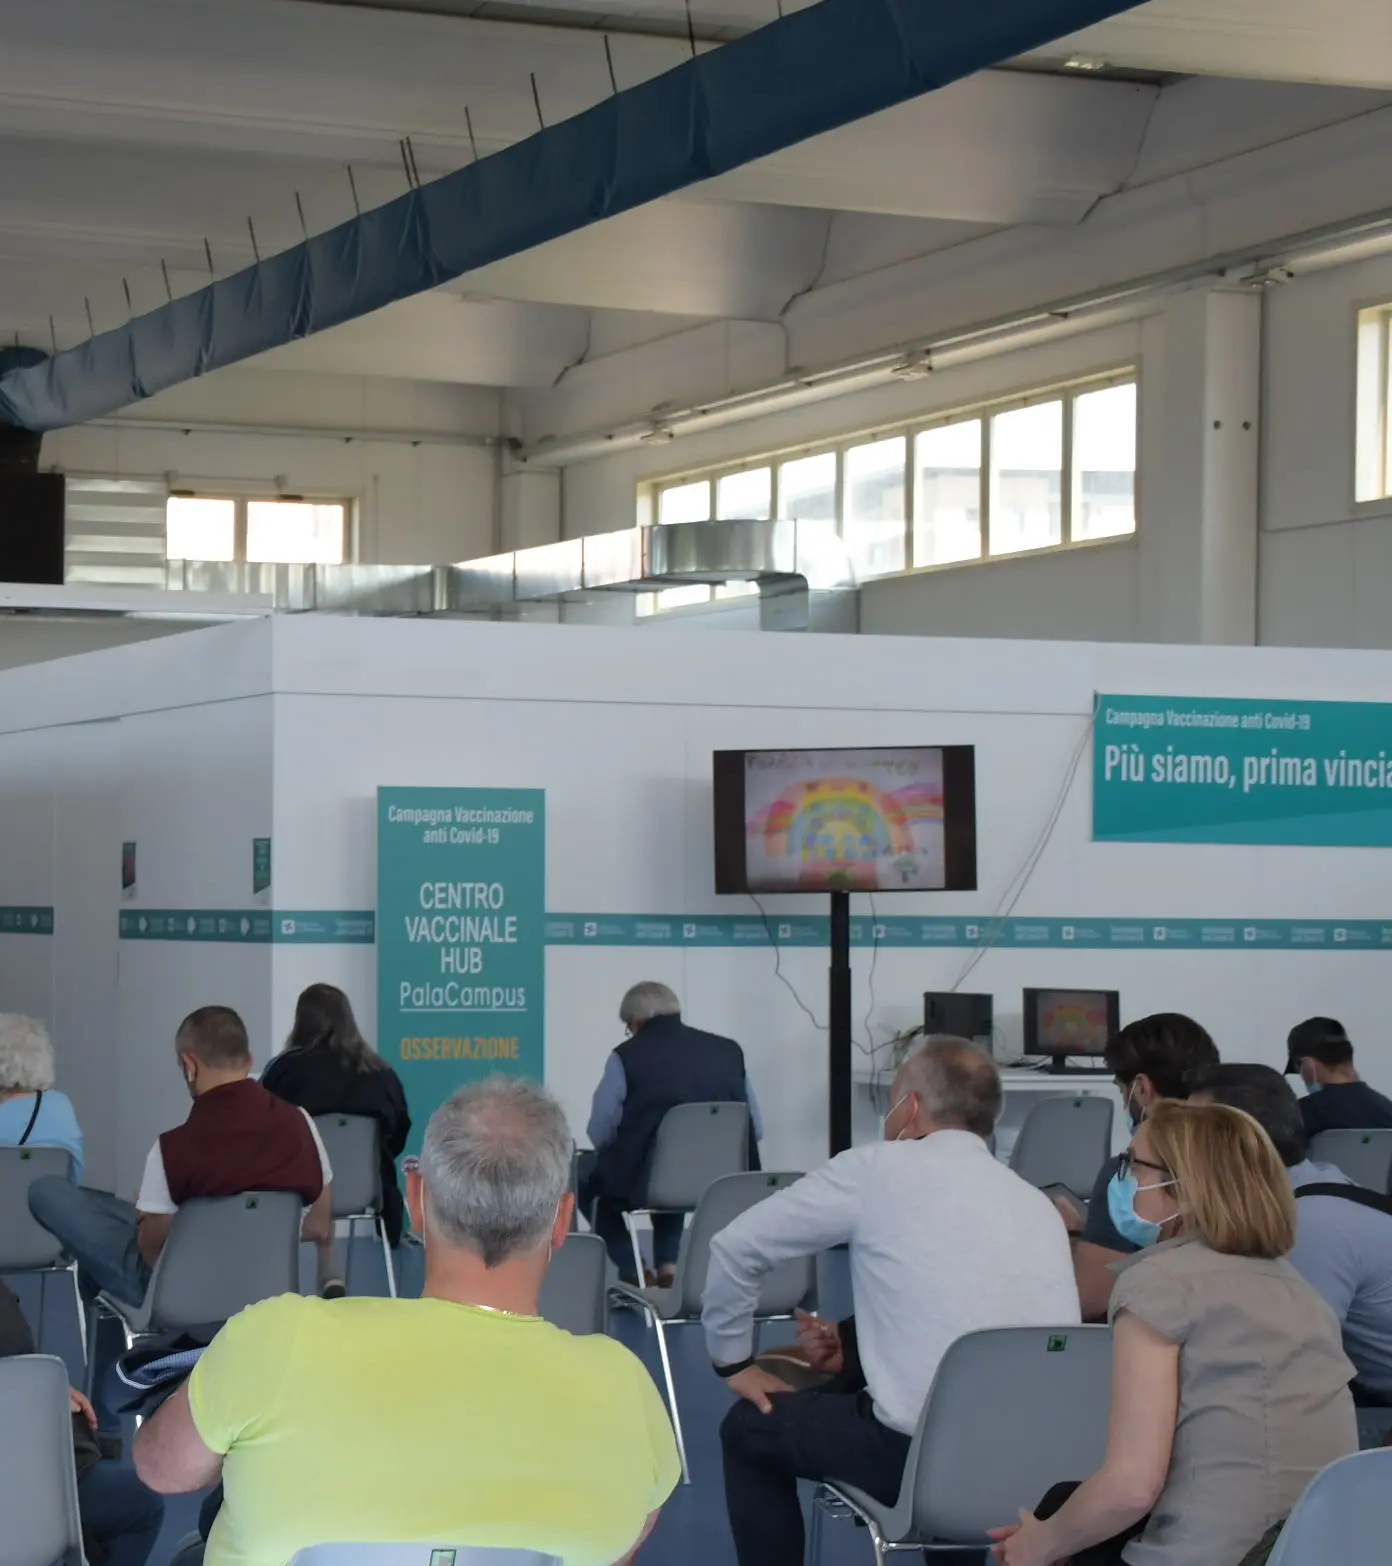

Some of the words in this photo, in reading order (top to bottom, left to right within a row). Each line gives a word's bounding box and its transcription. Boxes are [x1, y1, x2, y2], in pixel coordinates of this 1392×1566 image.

[1105, 708, 1164, 728] Campagna
[1166, 709, 1239, 729] Vaccinazione
[1240, 712, 1264, 729] anti
[1264, 712, 1311, 730] Covid-19
[1104, 743, 1145, 782] Più
[1151, 745, 1237, 789] siamo,
[1243, 748, 1317, 793] prima
[388, 805, 452, 826] Campagna
[455, 806, 534, 824] Vaccinazione
[423, 826, 447, 843] anti
[449, 827, 500, 844] Covid-19
[419, 882, 504, 909] CENTRO
[404, 915, 518, 943] VACCINALE
[440, 947, 483, 974] HUB
[400, 981, 526, 1010] PalaCampus
[400, 1036, 520, 1060] OSSERVAZIONE
